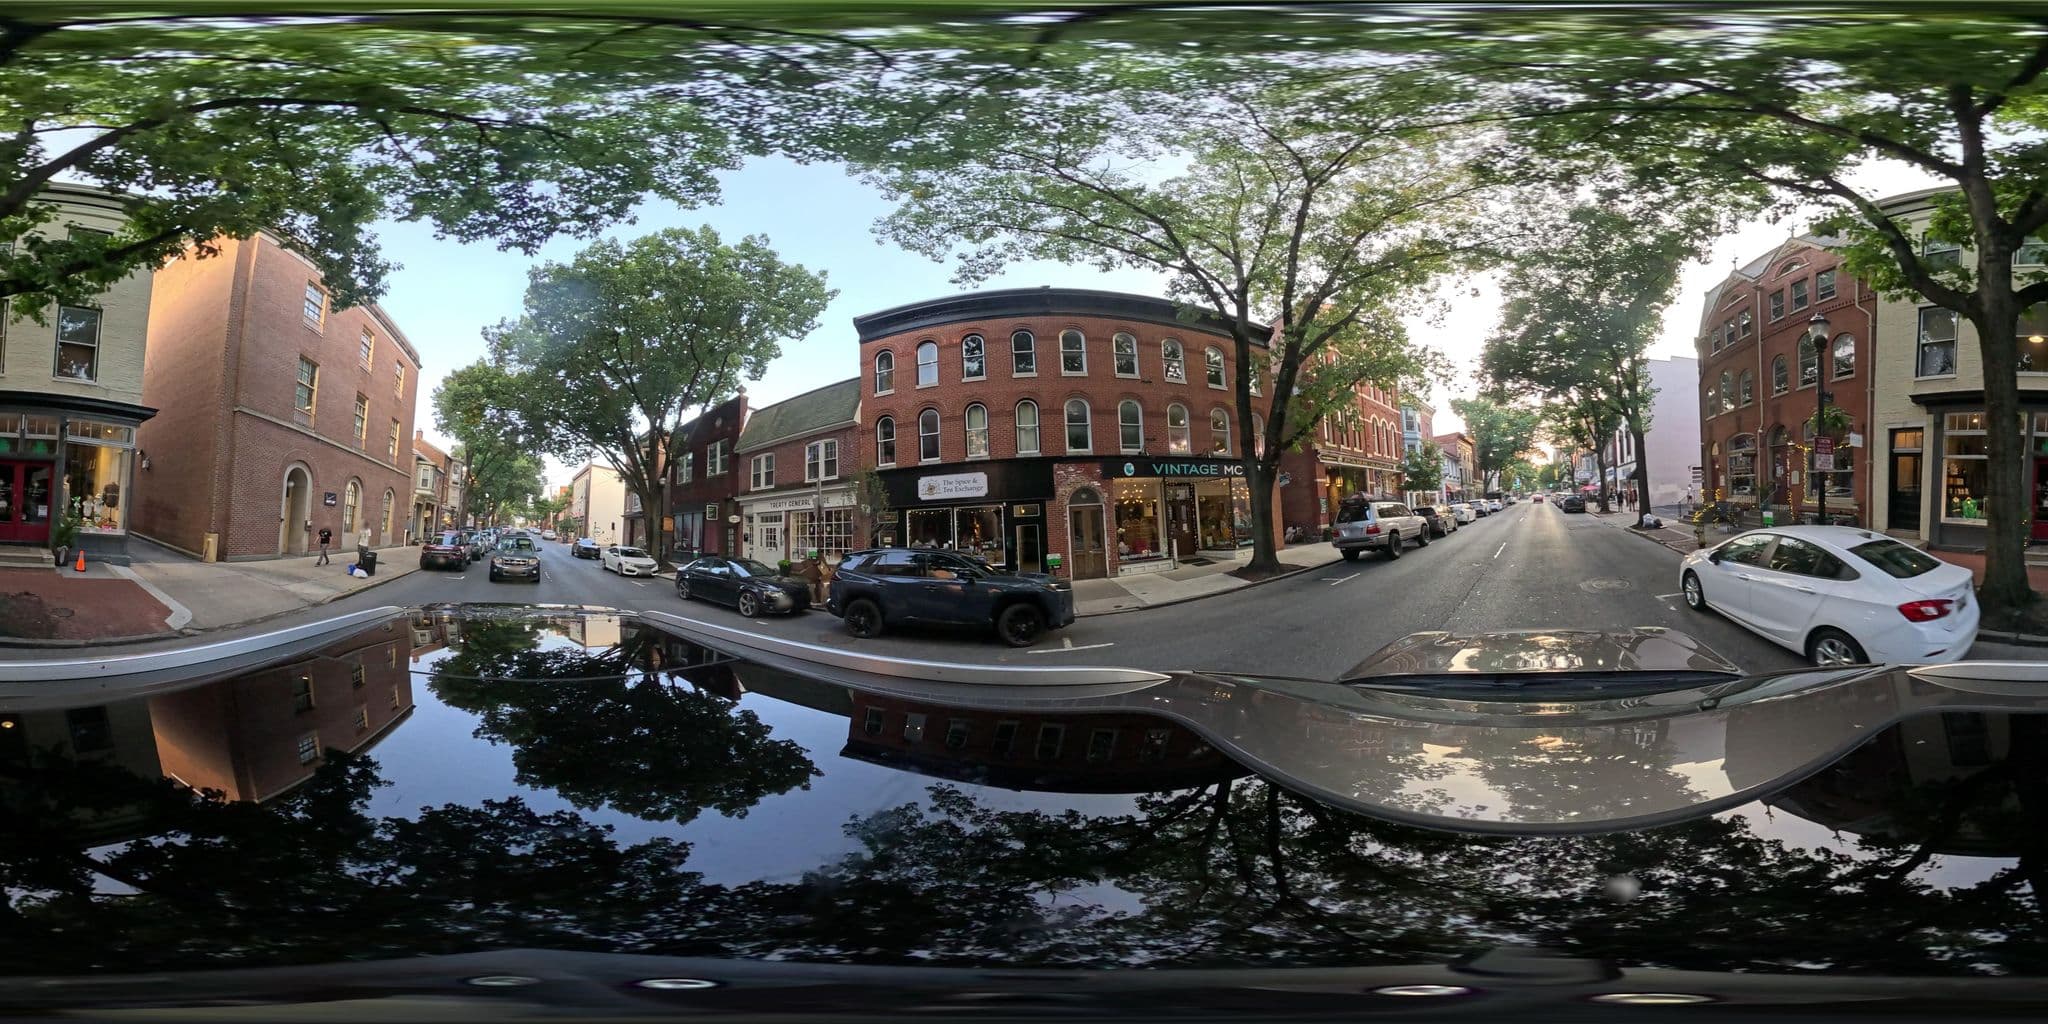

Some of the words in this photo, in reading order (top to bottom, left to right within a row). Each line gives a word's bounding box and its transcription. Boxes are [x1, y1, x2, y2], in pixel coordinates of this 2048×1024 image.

[1152, 463, 1218, 475] VINTAGE
[955, 479, 971, 487] Spice
[770, 501, 787, 509] TREATY
[789, 499, 810, 507] GENERAL
